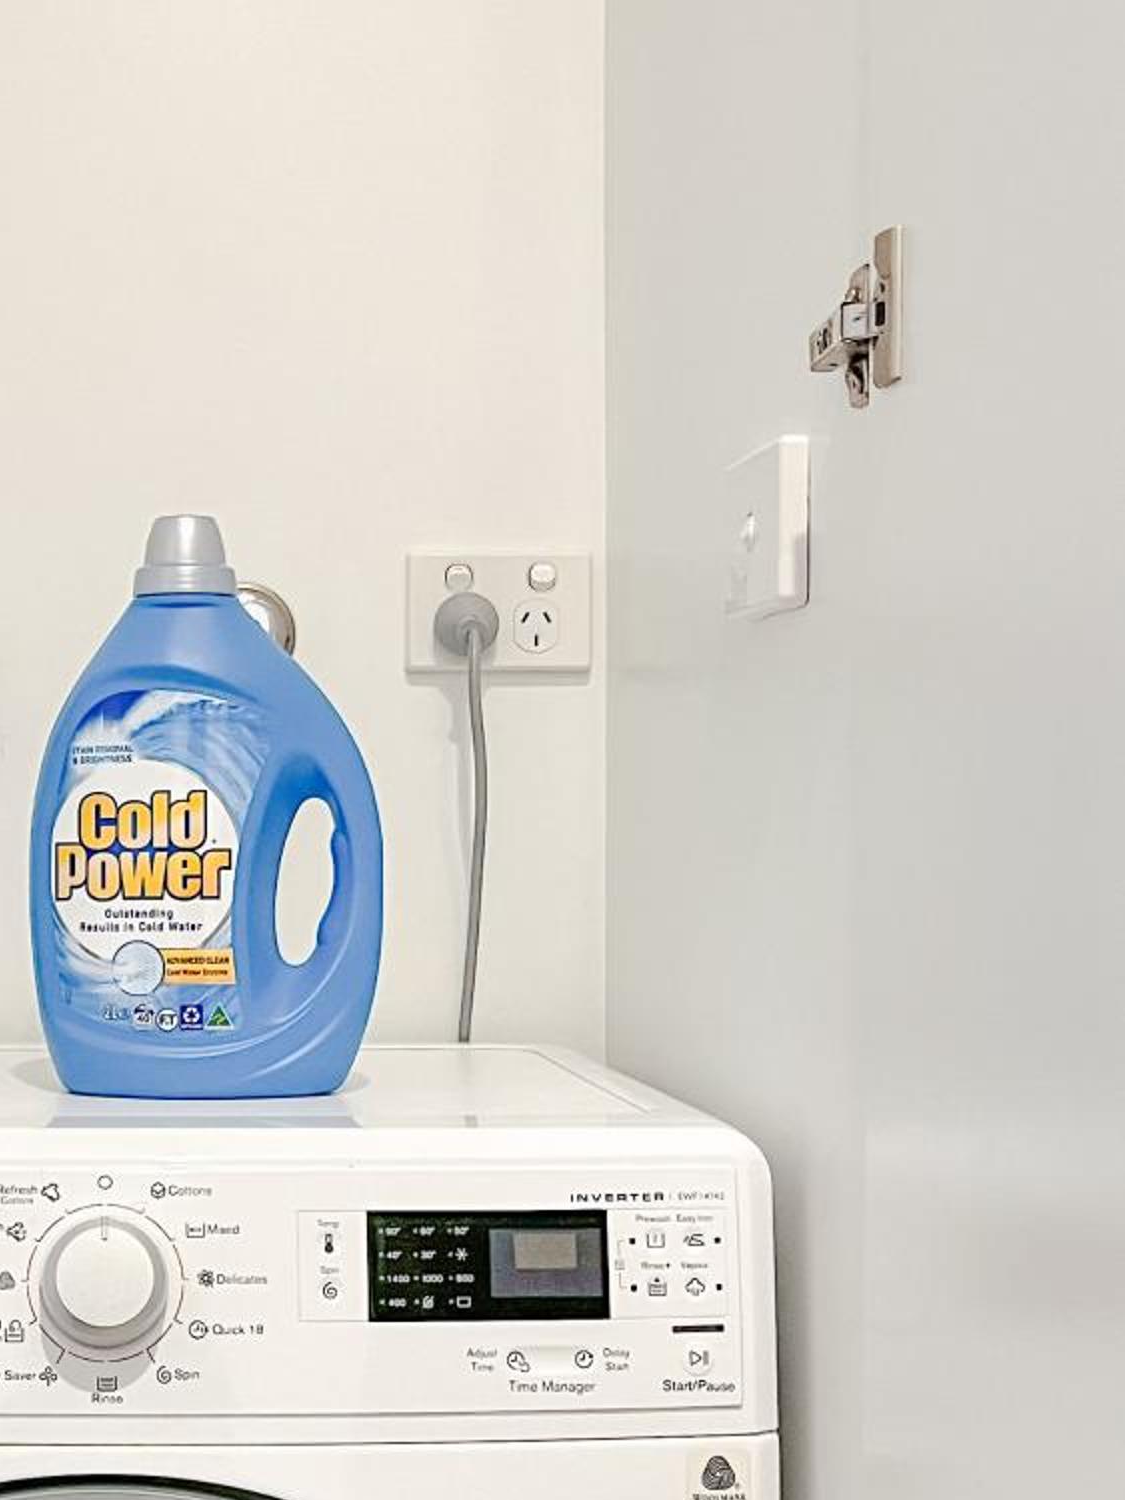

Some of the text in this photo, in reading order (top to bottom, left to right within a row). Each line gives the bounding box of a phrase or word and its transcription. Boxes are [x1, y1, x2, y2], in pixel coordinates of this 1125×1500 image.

[78, 790, 208, 850] Cold
[55, 842, 232, 902] Power
[105, 908, 174, 920] Outstanding
[81, 921, 203, 932] Results in Cold Water
[168, 1185, 213, 1197] Cottons
[571, 1192, 665, 1202] INVERTER
[217, 1274, 268, 1285] Delicates
[212, 1324, 245, 1335] Quick
[467, 1348, 497, 1360] Adjust
[603, 1348, 630, 1360] Delay
[471, 1362, 494, 1372] Time
[605, 1361, 629, 1372] Start
[5, 1370, 37, 1381] Saver
[174, 1369, 200, 1382] Spin
[509, 1380, 595, 1395] Time Manager
[662, 1378, 736, 1392] Start/Pause
[91, 1393, 123, 1404] Rinse
